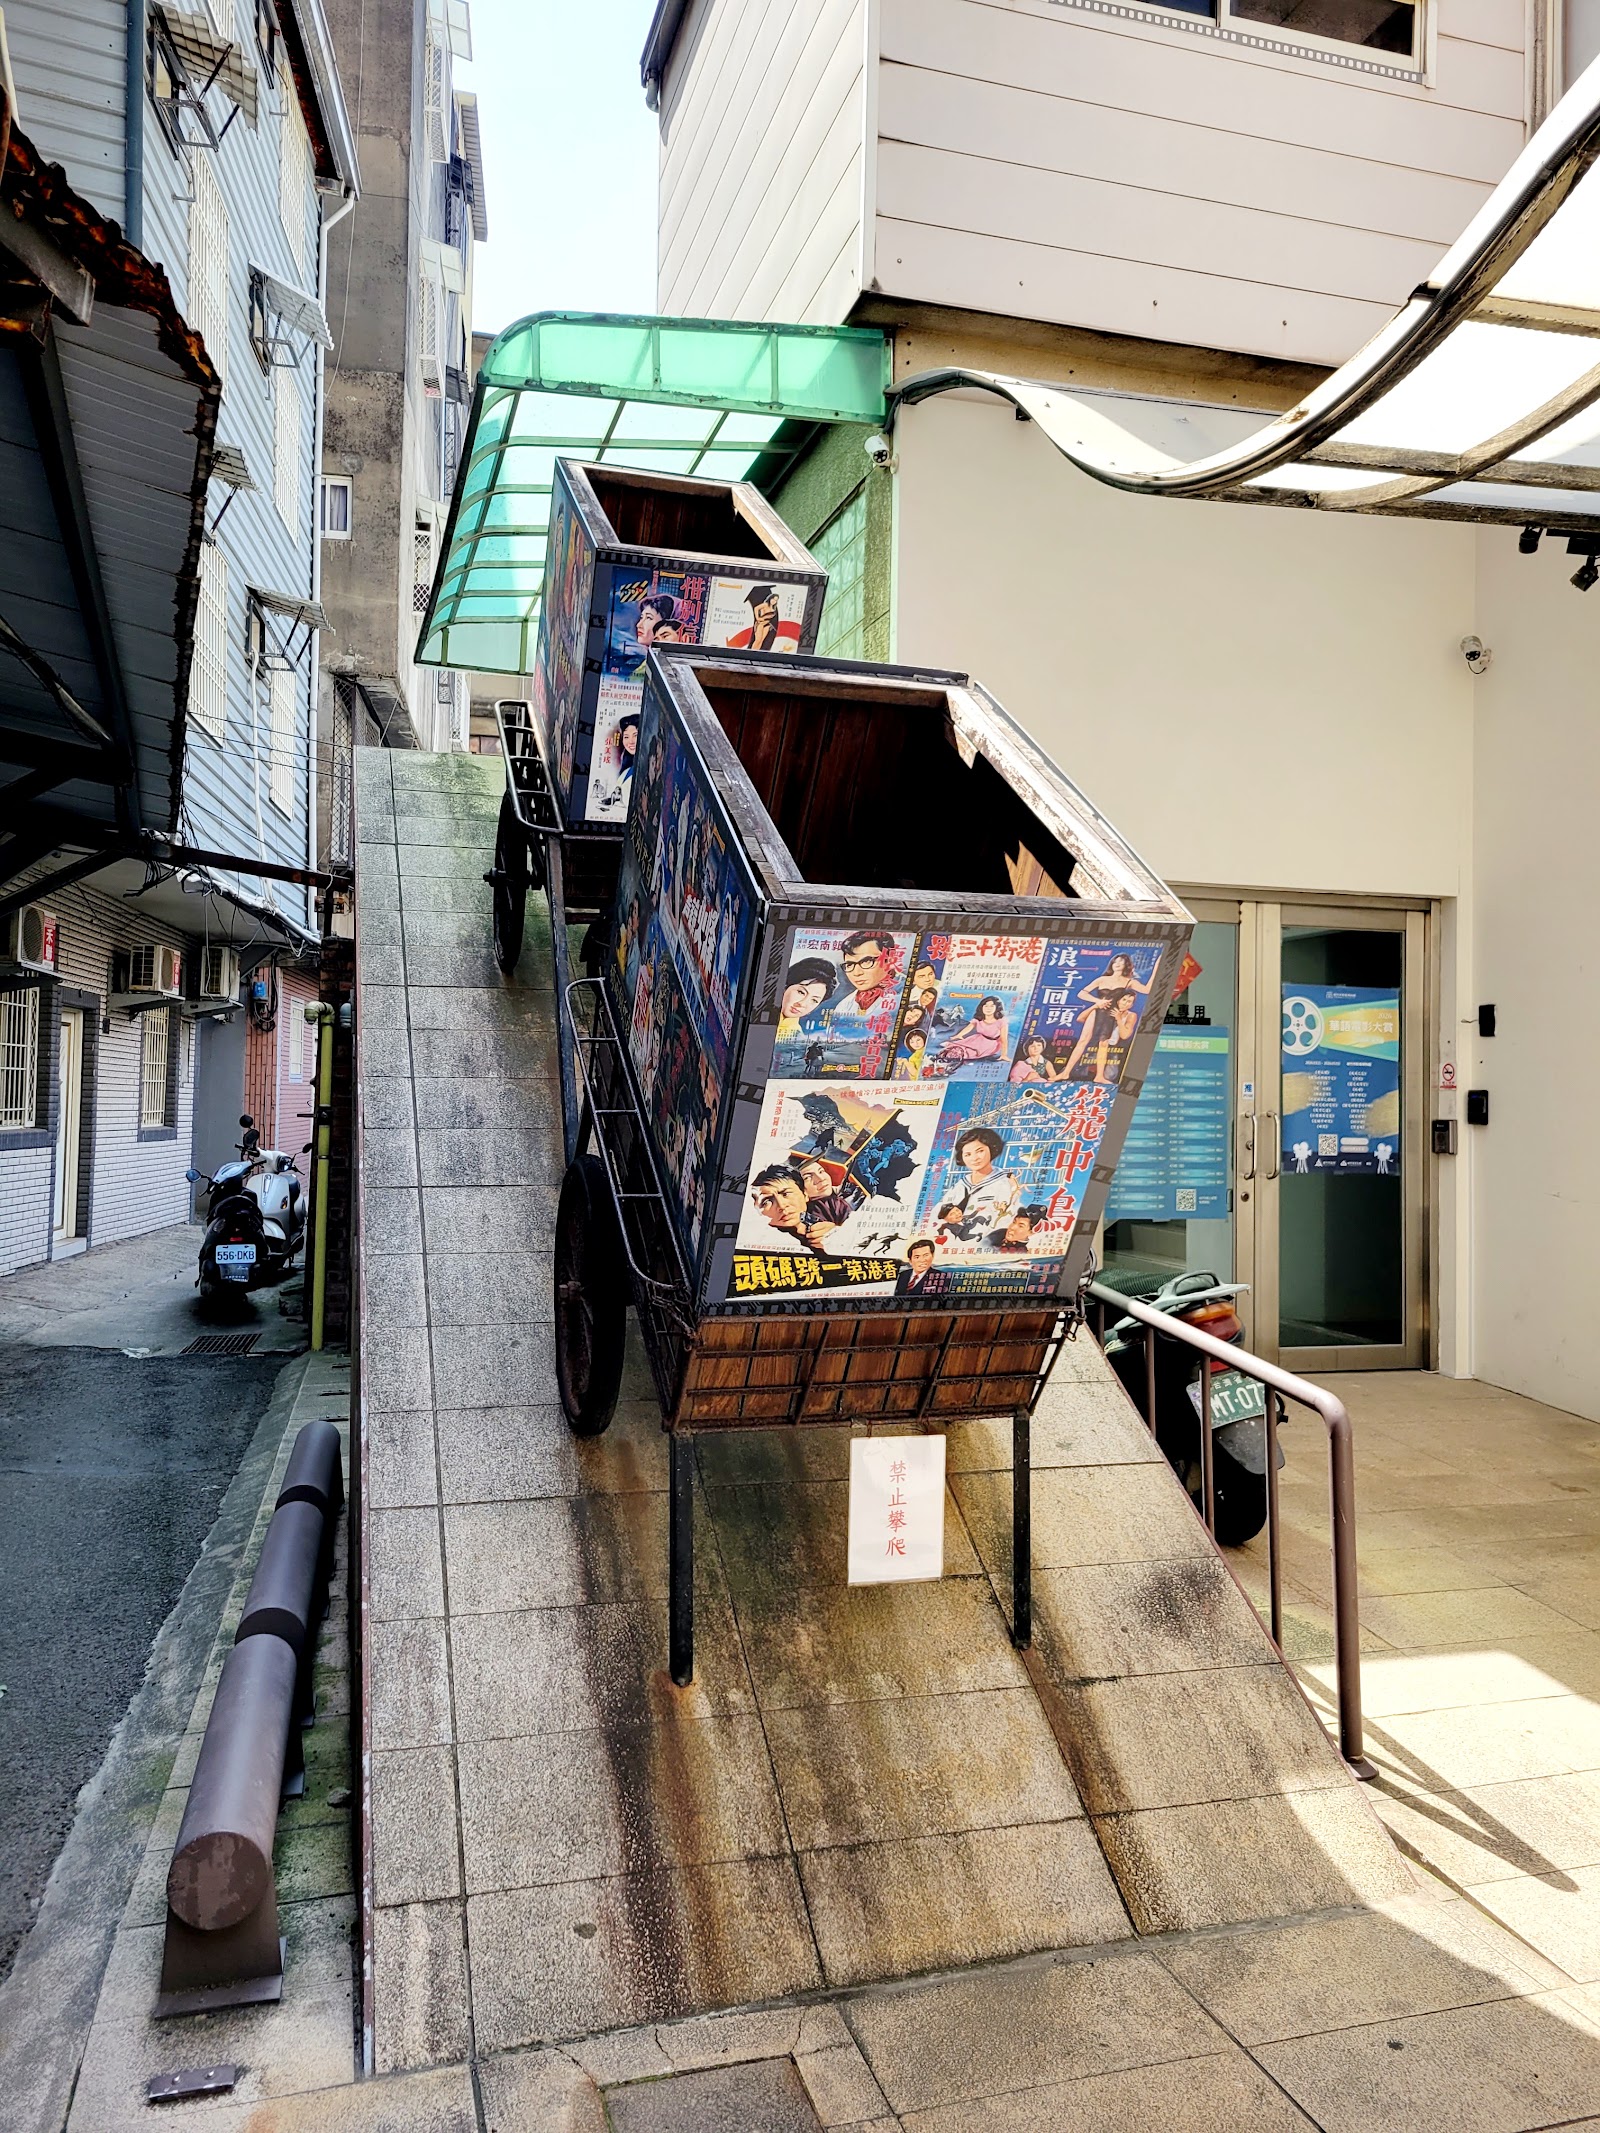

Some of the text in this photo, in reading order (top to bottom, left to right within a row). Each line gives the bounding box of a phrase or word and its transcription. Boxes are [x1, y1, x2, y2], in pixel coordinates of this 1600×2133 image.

[927, 935, 1042, 964] 港街十三號
[1042, 947, 1083, 1027] 浪子回頭
[856, 944, 907, 1079] 懷念的播音員
[1329, 1020, 1393, 1033] 華語電影大賞
[1159, 1039, 1210, 1050] 華語電影大賞
[1244, 1083, 1253, 1093] 推
[1033, 1085, 1110, 1234] 籠中鳥
[733, 1254, 898, 1292] 香港第一號碼頭
[885, 1460, 908, 1557] 禁止攀爬
